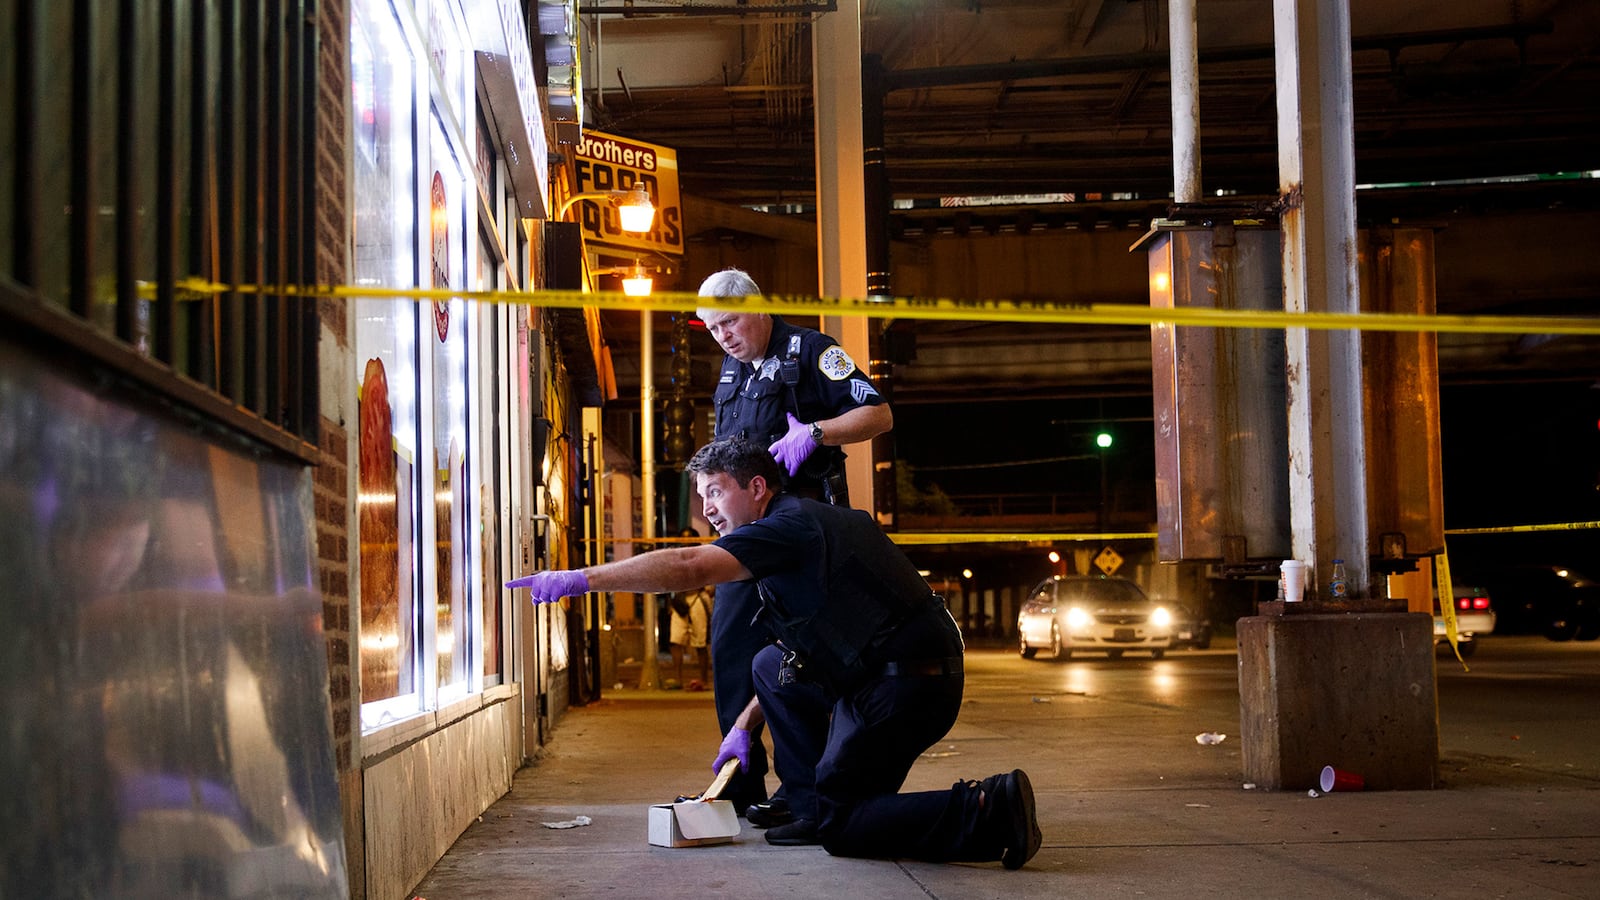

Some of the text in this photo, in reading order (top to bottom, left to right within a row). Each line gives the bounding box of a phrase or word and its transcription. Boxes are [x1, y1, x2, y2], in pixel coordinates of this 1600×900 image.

[576, 136, 654, 170] Brothers
[583, 199, 680, 246] QUS
[824, 350, 845, 370] CHICAGO
[834, 362, 852, 376] POLICE
